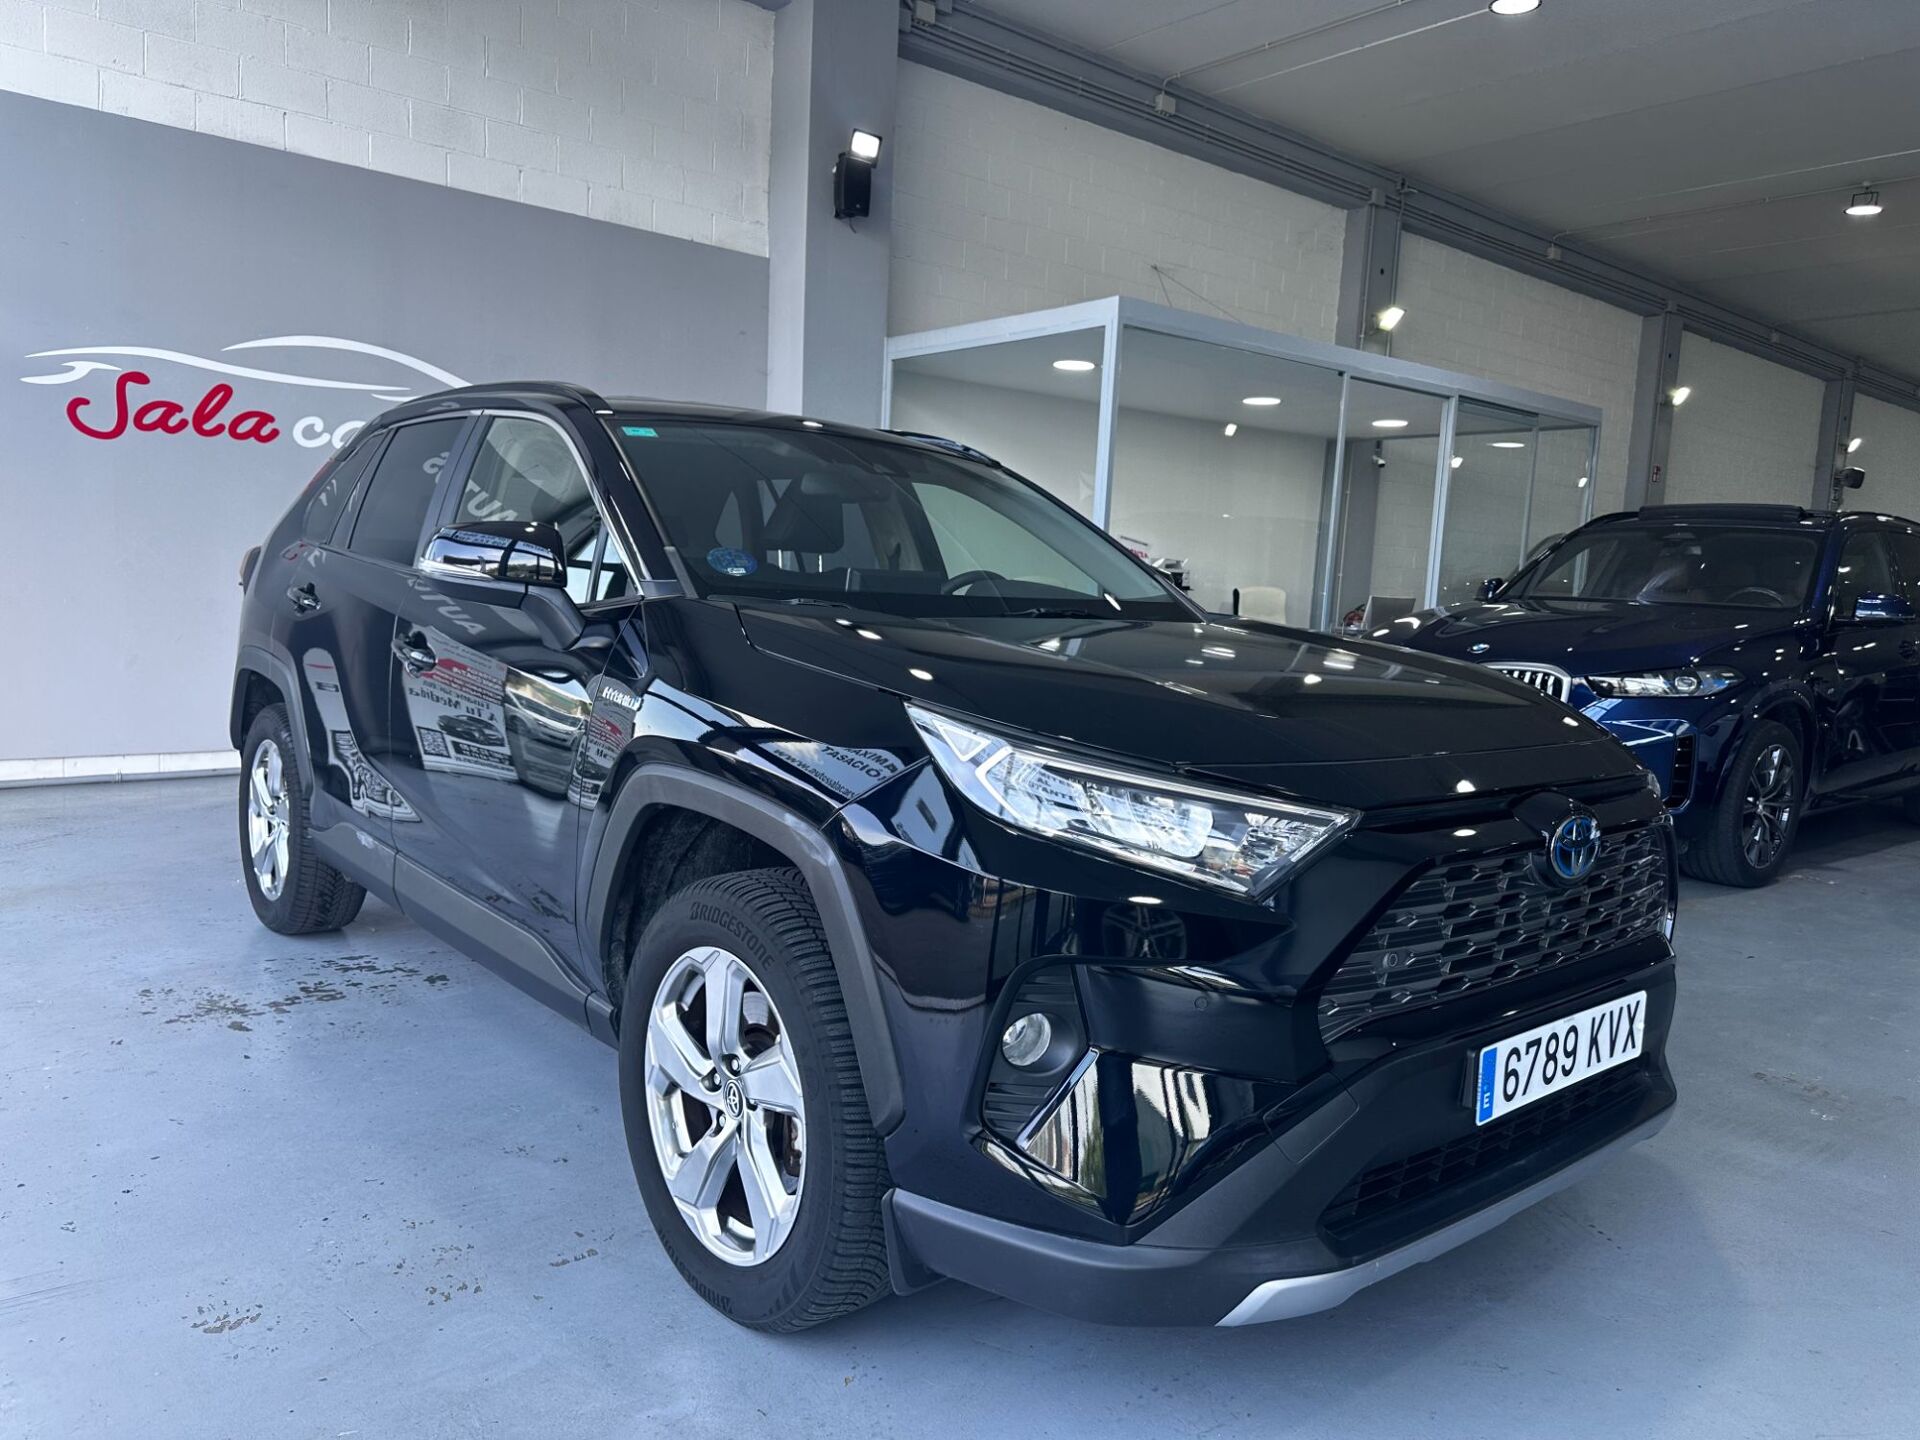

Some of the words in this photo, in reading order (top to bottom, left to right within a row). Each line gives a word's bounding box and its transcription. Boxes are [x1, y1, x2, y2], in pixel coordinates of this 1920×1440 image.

[66, 371, 280, 443] Sala
[690, 902, 775, 972] BRIDGESTONE
[1503, 1025, 1579, 1102] 6789
[1587, 1000, 1640, 1068] KVX
